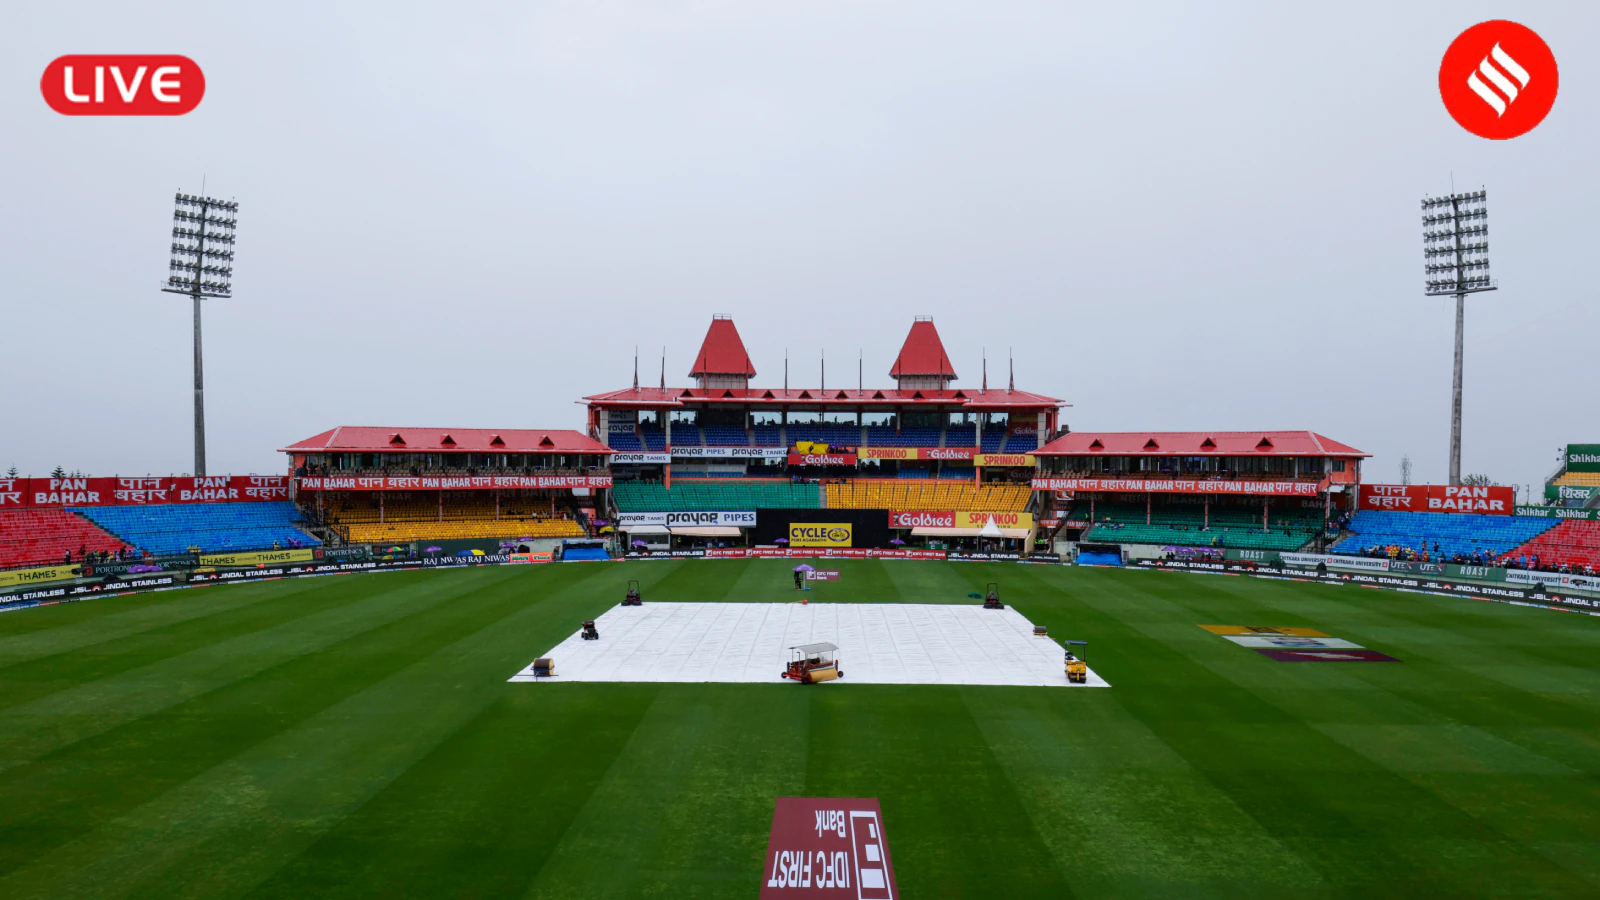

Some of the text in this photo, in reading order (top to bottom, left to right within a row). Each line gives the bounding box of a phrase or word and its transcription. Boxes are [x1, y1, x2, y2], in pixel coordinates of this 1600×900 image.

[614, 454, 645, 462] prayag
[671, 448, 703, 456] prayag
[732, 449, 763, 457] prayag
[867, 449, 907, 459] SPRINKOO
[930, 449, 970, 459] Goldiee
[805, 454, 844, 464] Goldiee
[983, 455, 1025, 465] SPRINKOO
[1569, 454, 1600, 463] Shikha
[50, 479, 87, 490] PAN
[119, 478, 162, 490] पान
[193, 477, 226, 488] PAN
[251, 476, 284, 487] पान
[301, 476, 612, 489] PAN BAHAR पान बहार PAN BAHAR पान बहार PAN BAHAR पान बहार
[1032, 479, 1317, 493] PAN BAHAR पान बहार PAN BAHAR पान बहार PAN BAHAR पान बहार
[113, 490, 168, 502] बहार
[181, 489, 239, 500] BAHAR
[244, 487, 288, 498] बहार
[1373, 485, 1408, 496] पान
[1445, 486, 1488, 498] PAN
[35, 491, 100, 504] BAHAR
[1368, 496, 1412, 508] बहार
[1428, 498, 1504, 510] BAHAR
[666, 512, 755, 525] prayag PIPES
[1516, 507, 1549, 517] Shikhar
[1555, 508, 1590, 519] Shikhar
[900, 512, 953, 527] Goldiee
[791, 528, 827, 538] CYCLE
[201, 557, 236, 565] THAMES
[257, 553, 291, 561] THAMES
[423, 557, 438, 565] RAJ
[468, 555, 483, 564] RAJ
[484, 554, 510, 563] NIWAS
[1240, 550, 1265, 559] ROAST
[17, 570, 57, 581] THAMES
[219, 571, 245, 579] JINDAL
[246, 568, 283, 577] STAINLESS
[287, 566, 306, 574] JSL
[1460, 566, 1489, 577] ROAST
[1531, 575, 1562, 583] UNIVERSITY
[23, 588, 65, 600] STAINLESS
[70, 586, 92, 595] JSL
[103, 582, 131, 591] JINDAL
[132, 577, 172, 587] STAINLESS
[1281, 568, 1319, 577] STAINLESS
[1378, 577, 1418, 586] STAINLESS
[1453, 585, 1480, 593] JINDAL
[1482, 588, 1524, 598] STAINLESS
[1562, 596, 1591, 606] JINDAL
[814, 810, 847, 838] Bank
[767, 850, 850, 889] IDFC FIRST
